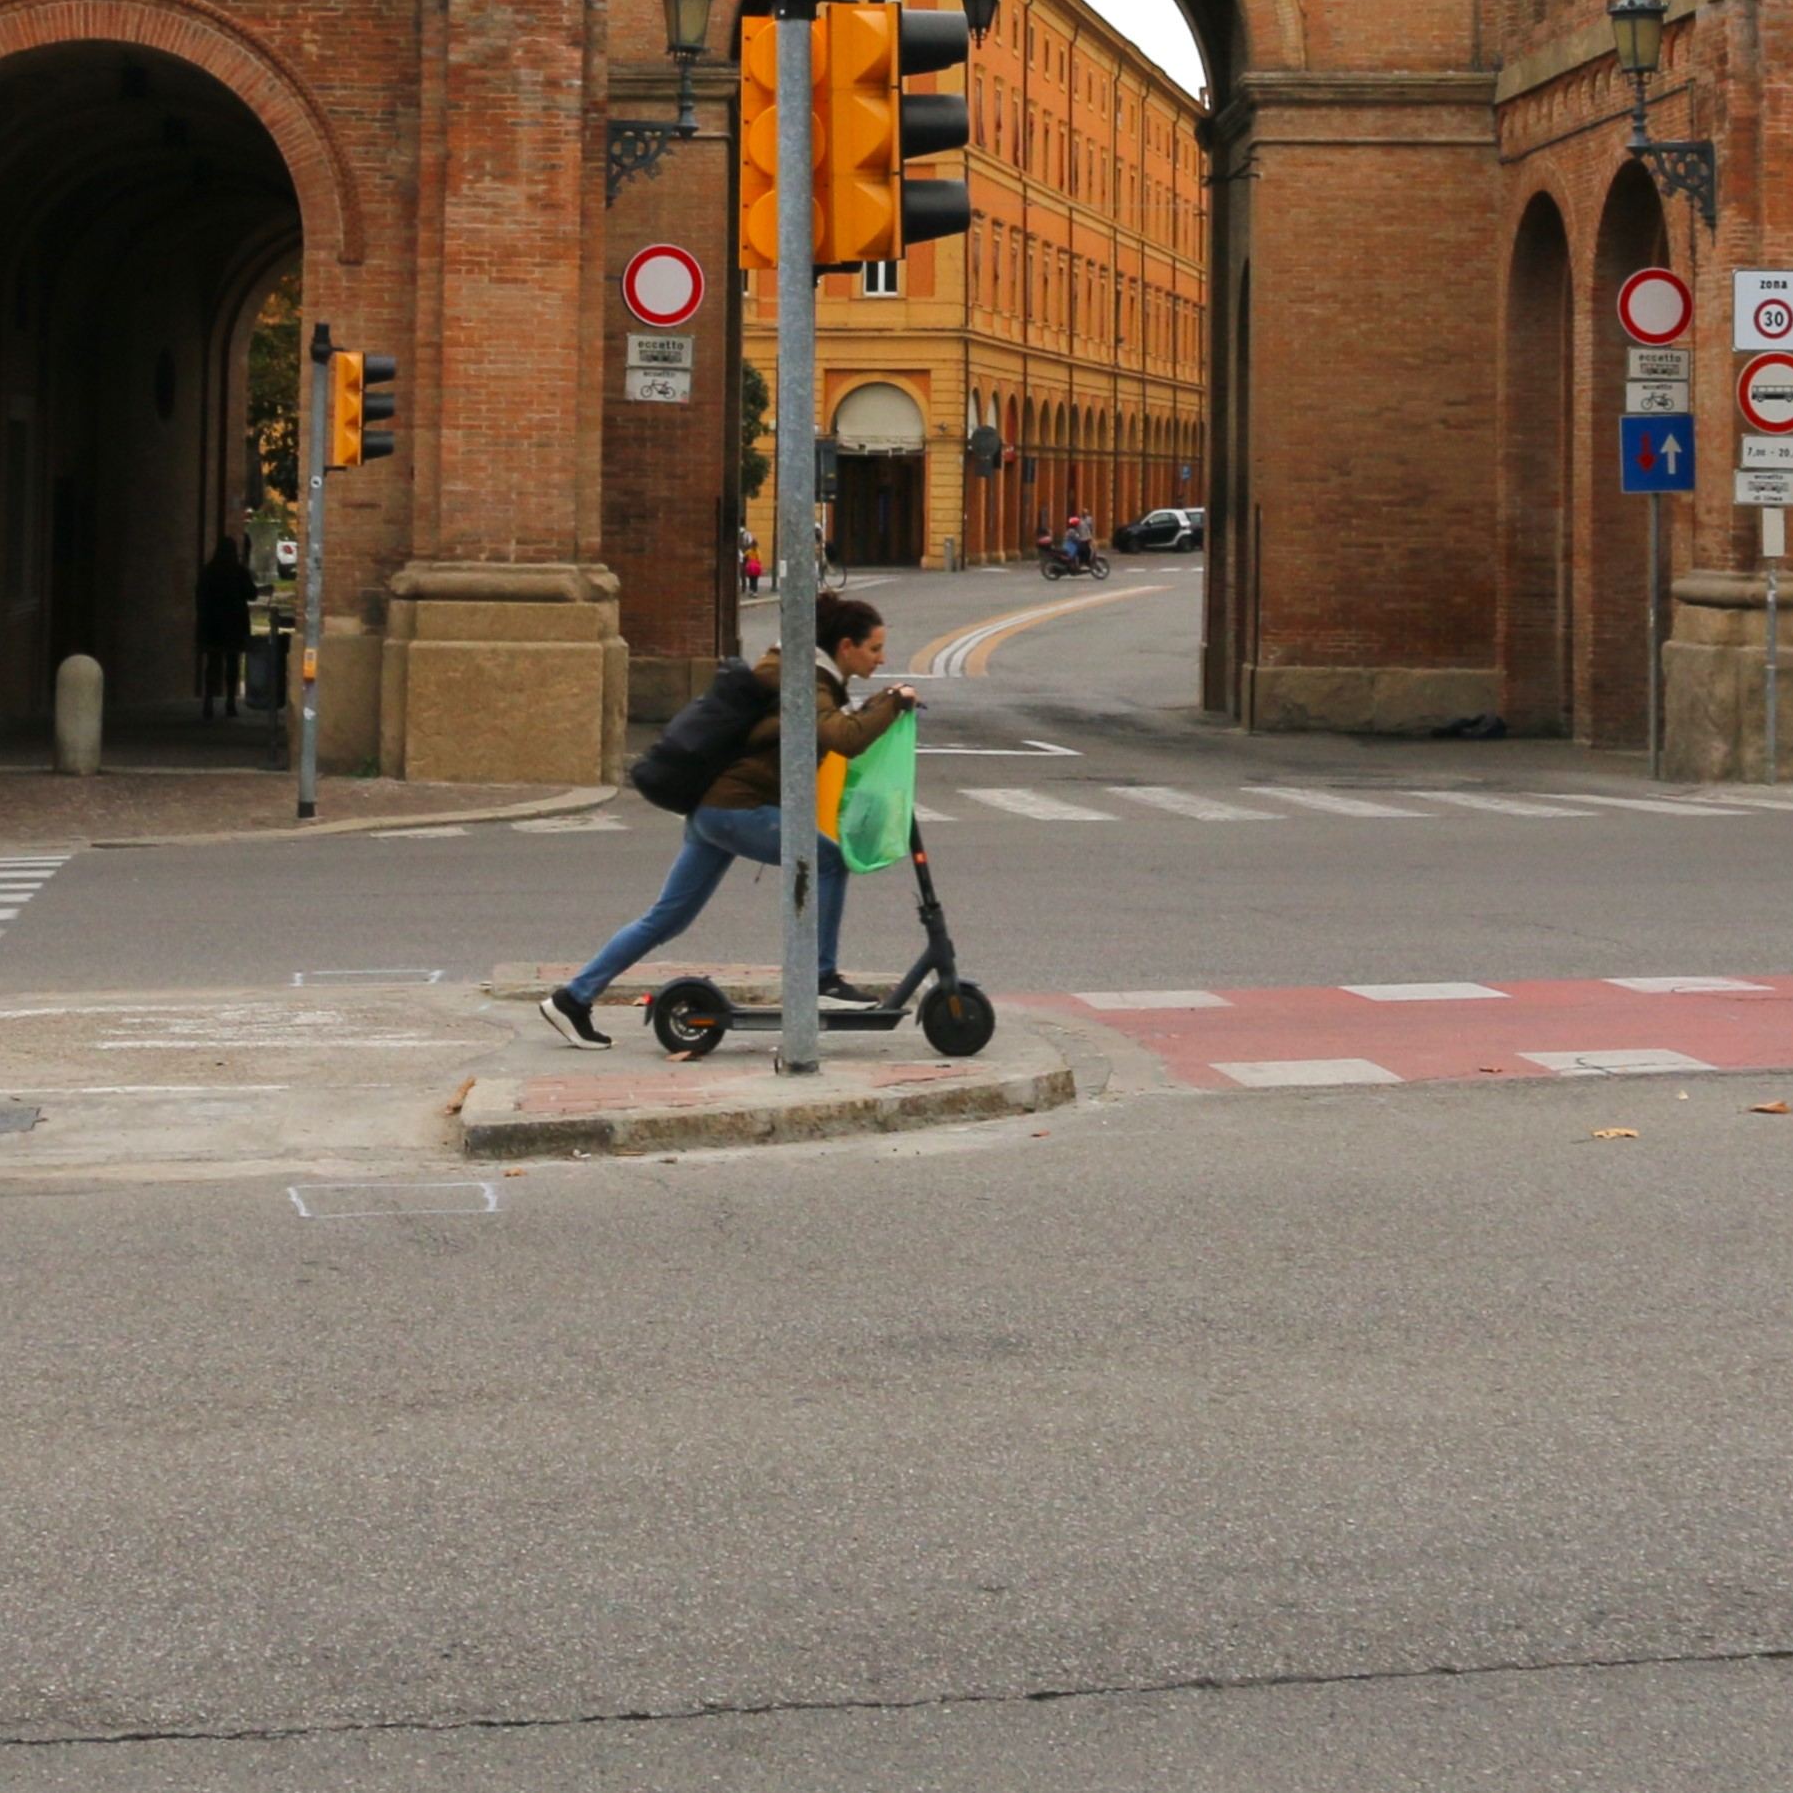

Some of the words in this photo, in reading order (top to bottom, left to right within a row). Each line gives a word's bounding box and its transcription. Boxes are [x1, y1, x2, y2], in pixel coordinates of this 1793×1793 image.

[1760, 280, 1788, 289] zona
[1764, 311, 1784, 327] 30
[638, 340, 684, 350] eccetto
[1639, 354, 1681, 362] eccetto
